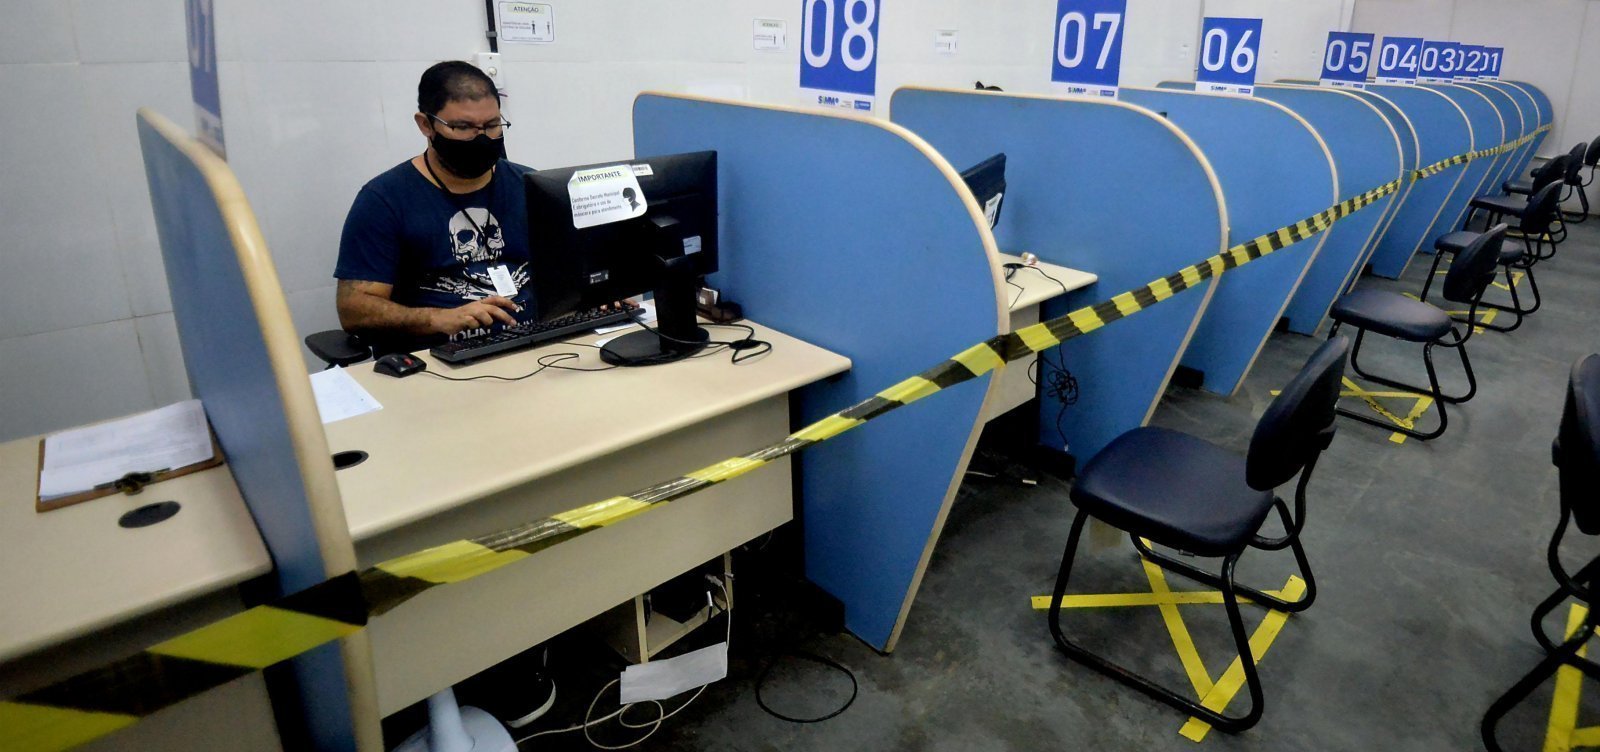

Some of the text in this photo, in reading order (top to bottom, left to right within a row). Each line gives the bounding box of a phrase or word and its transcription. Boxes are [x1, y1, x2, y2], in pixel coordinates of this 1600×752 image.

[803, 0, 876, 72] 08
[1057, 11, 1121, 70] 07
[1202, 28, 1255, 74] 06
[1325, 39, 1370, 74] 05
[1380, 43, 1418, 72] 04
[1421, 47, 1456, 73] 03
[578, 171, 621, 183] IMPORTANTE
